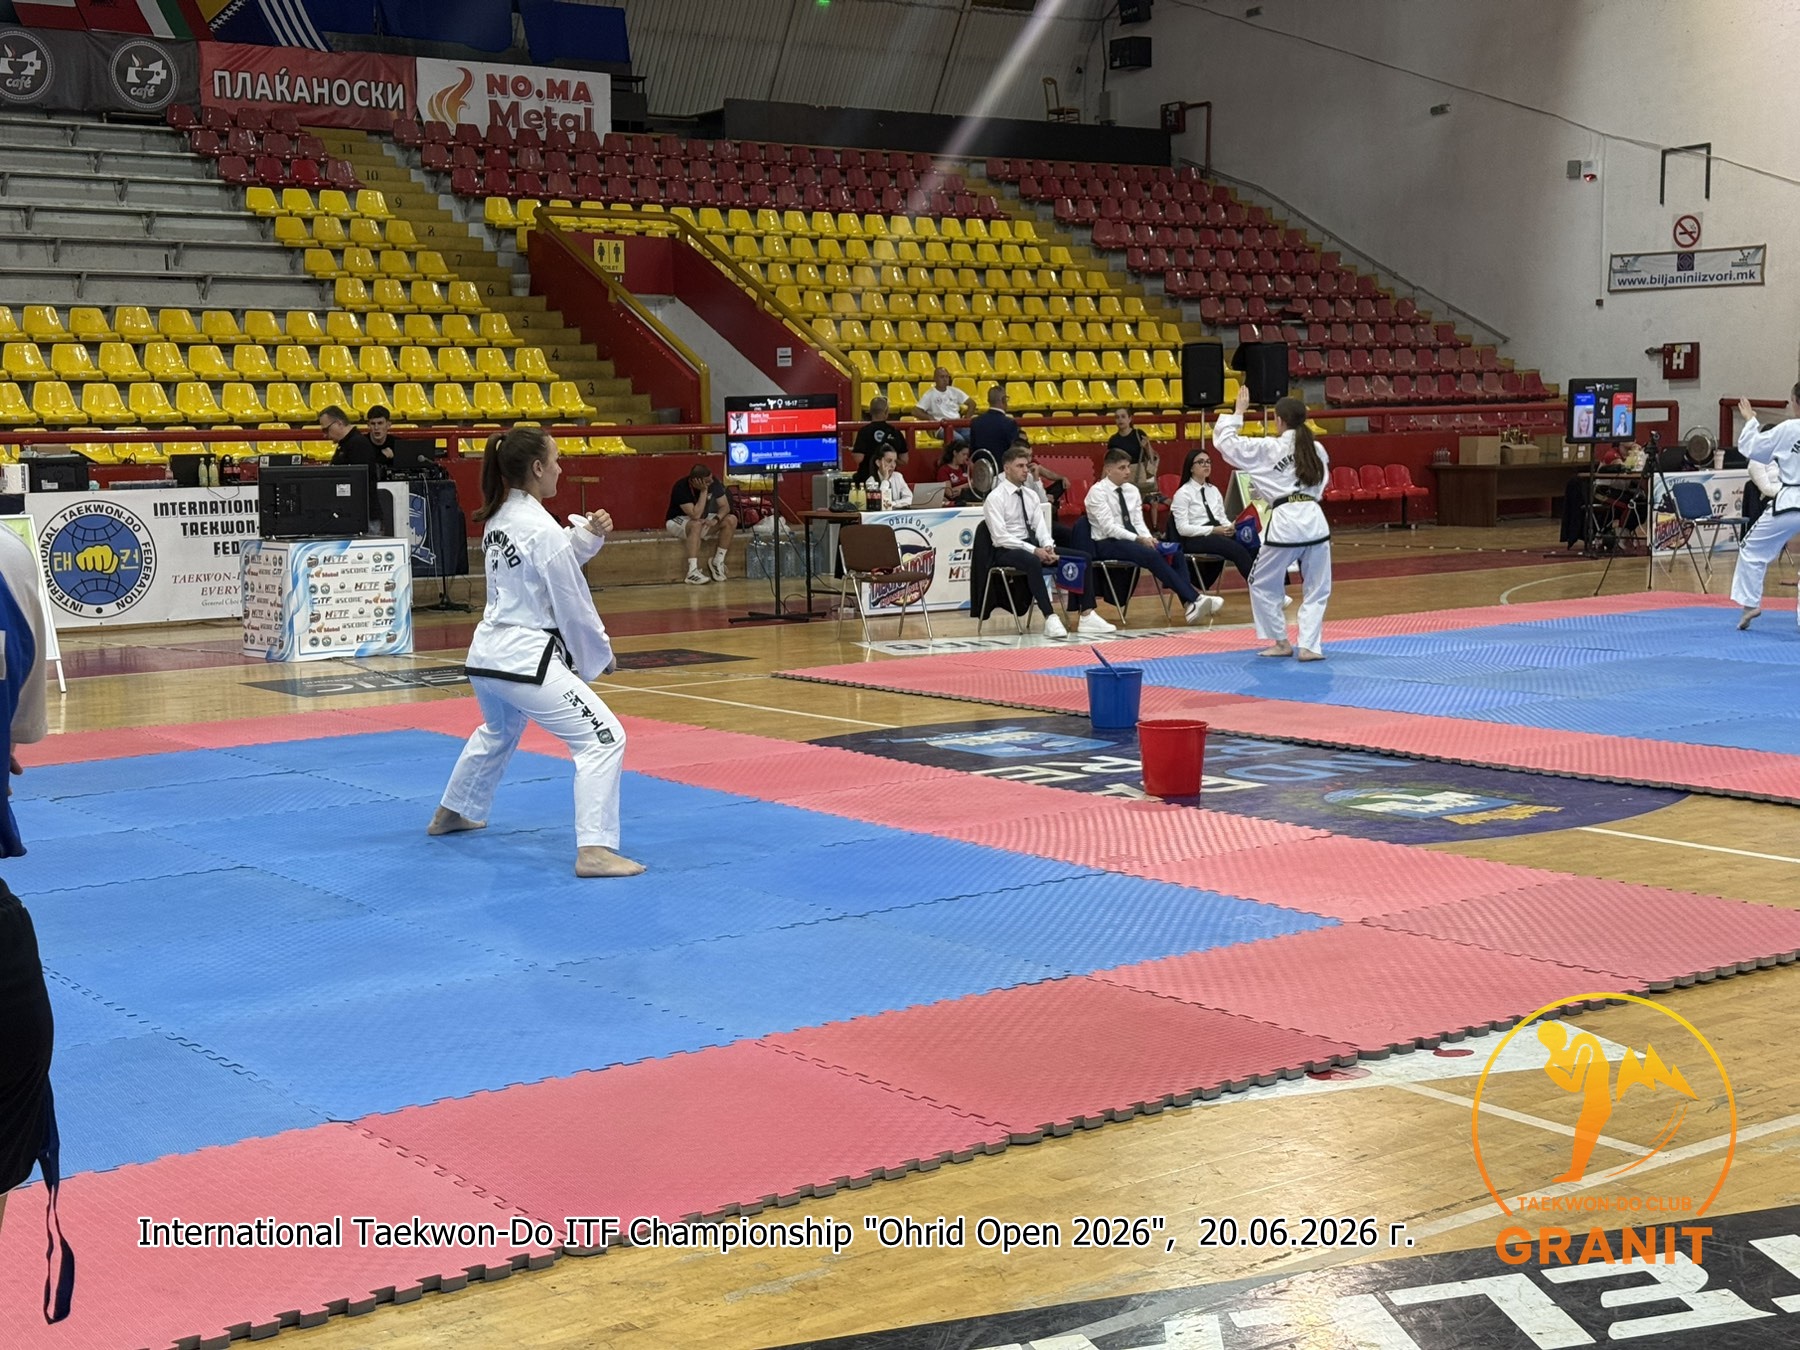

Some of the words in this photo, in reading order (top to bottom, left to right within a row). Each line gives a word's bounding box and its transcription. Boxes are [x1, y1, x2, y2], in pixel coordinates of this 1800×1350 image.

[6, 76, 32, 89] café
[486, 73, 594, 103] NO.MA
[130, 84, 155, 98] café
[213, 70, 404, 110] ПЛАЌАНОСКИ
[488, 99, 594, 134] Metal
[341, 143, 353, 155] 11
[365, 169, 379, 181] 10
[1617, 269, 1756, 287] www.biljaniniizvori.mk
[486, 283, 494, 295] 6
[522, 315, 529, 328] 5
[551, 347, 560, 361] 4
[587, 383, 594, 396] 3
[889, 516, 914, 527] Ohrid
[60, 504, 142, 534] TAEKWON-DO
[116, 542, 153, 611] FEDERATION
[172, 573, 240, 584] TAEKWON-
